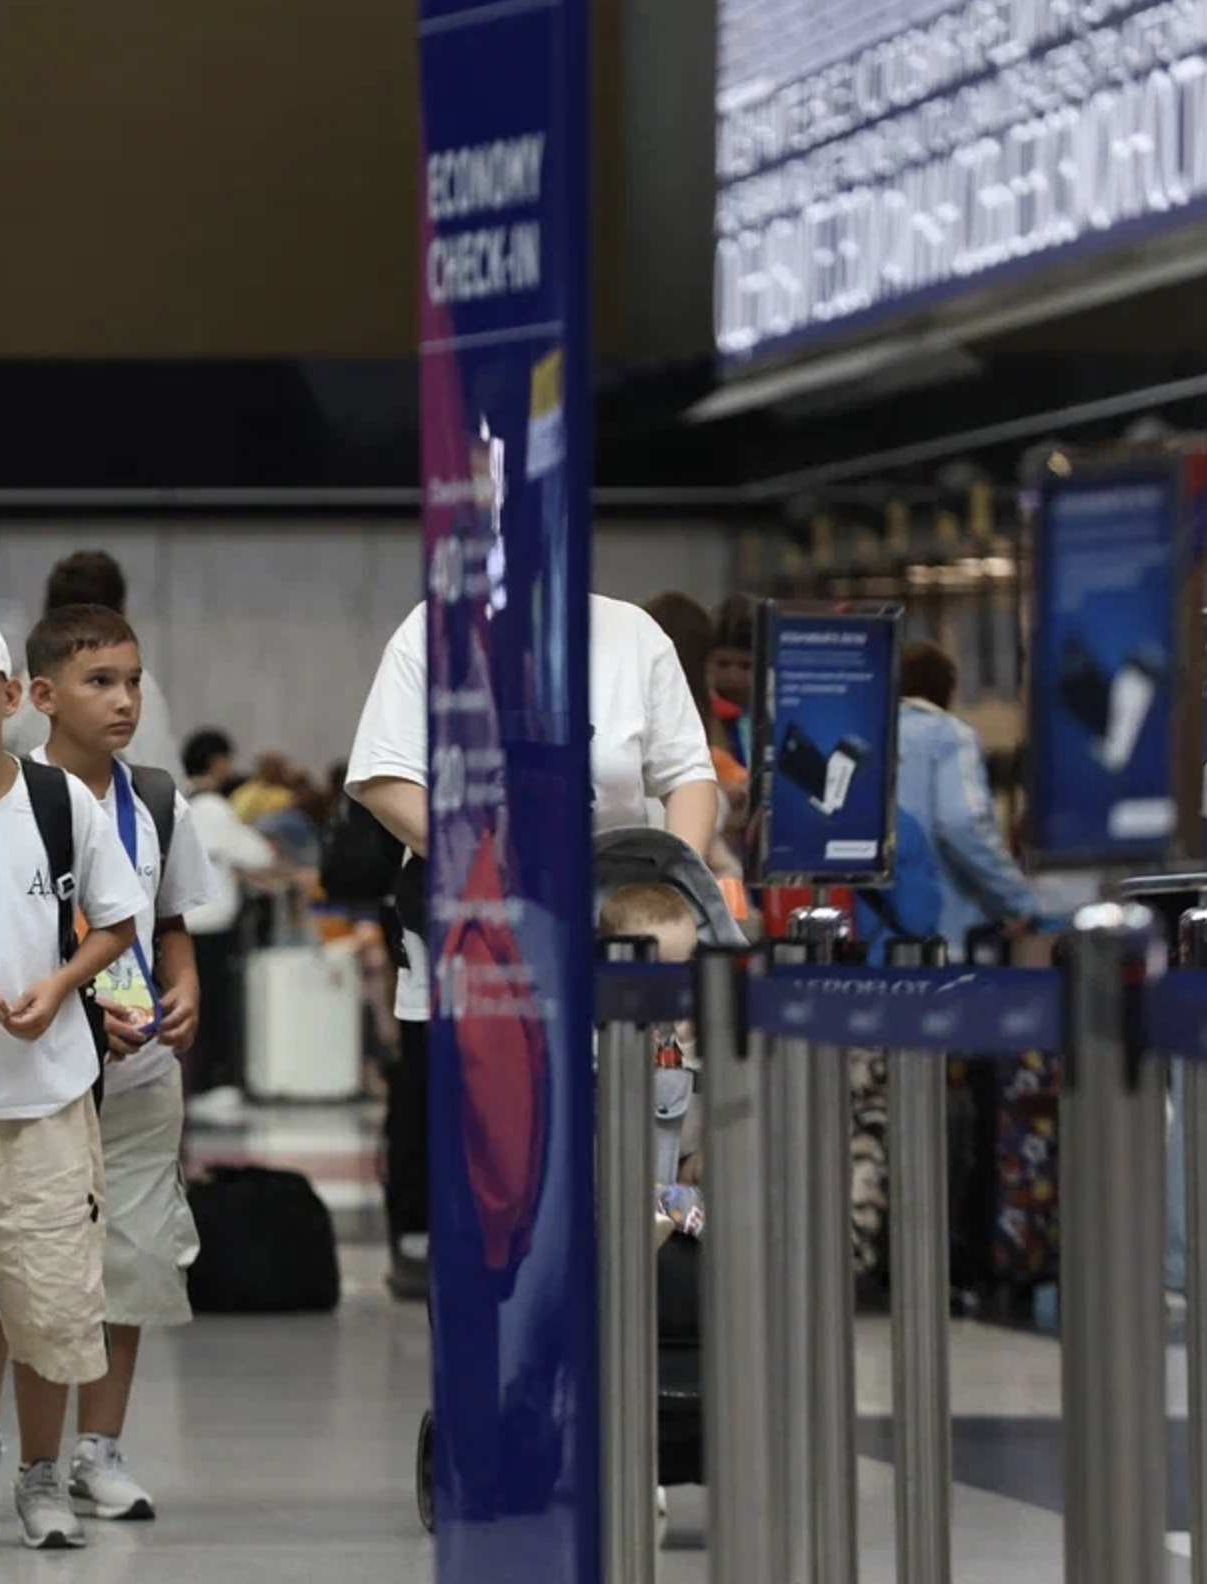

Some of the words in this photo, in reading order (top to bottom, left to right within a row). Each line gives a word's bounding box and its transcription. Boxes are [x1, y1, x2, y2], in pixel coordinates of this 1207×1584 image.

[427, 131, 545, 220] ECONOMY
[427, 220, 541, 306] CHECK-IN
[436, 954, 469, 1020] 10
